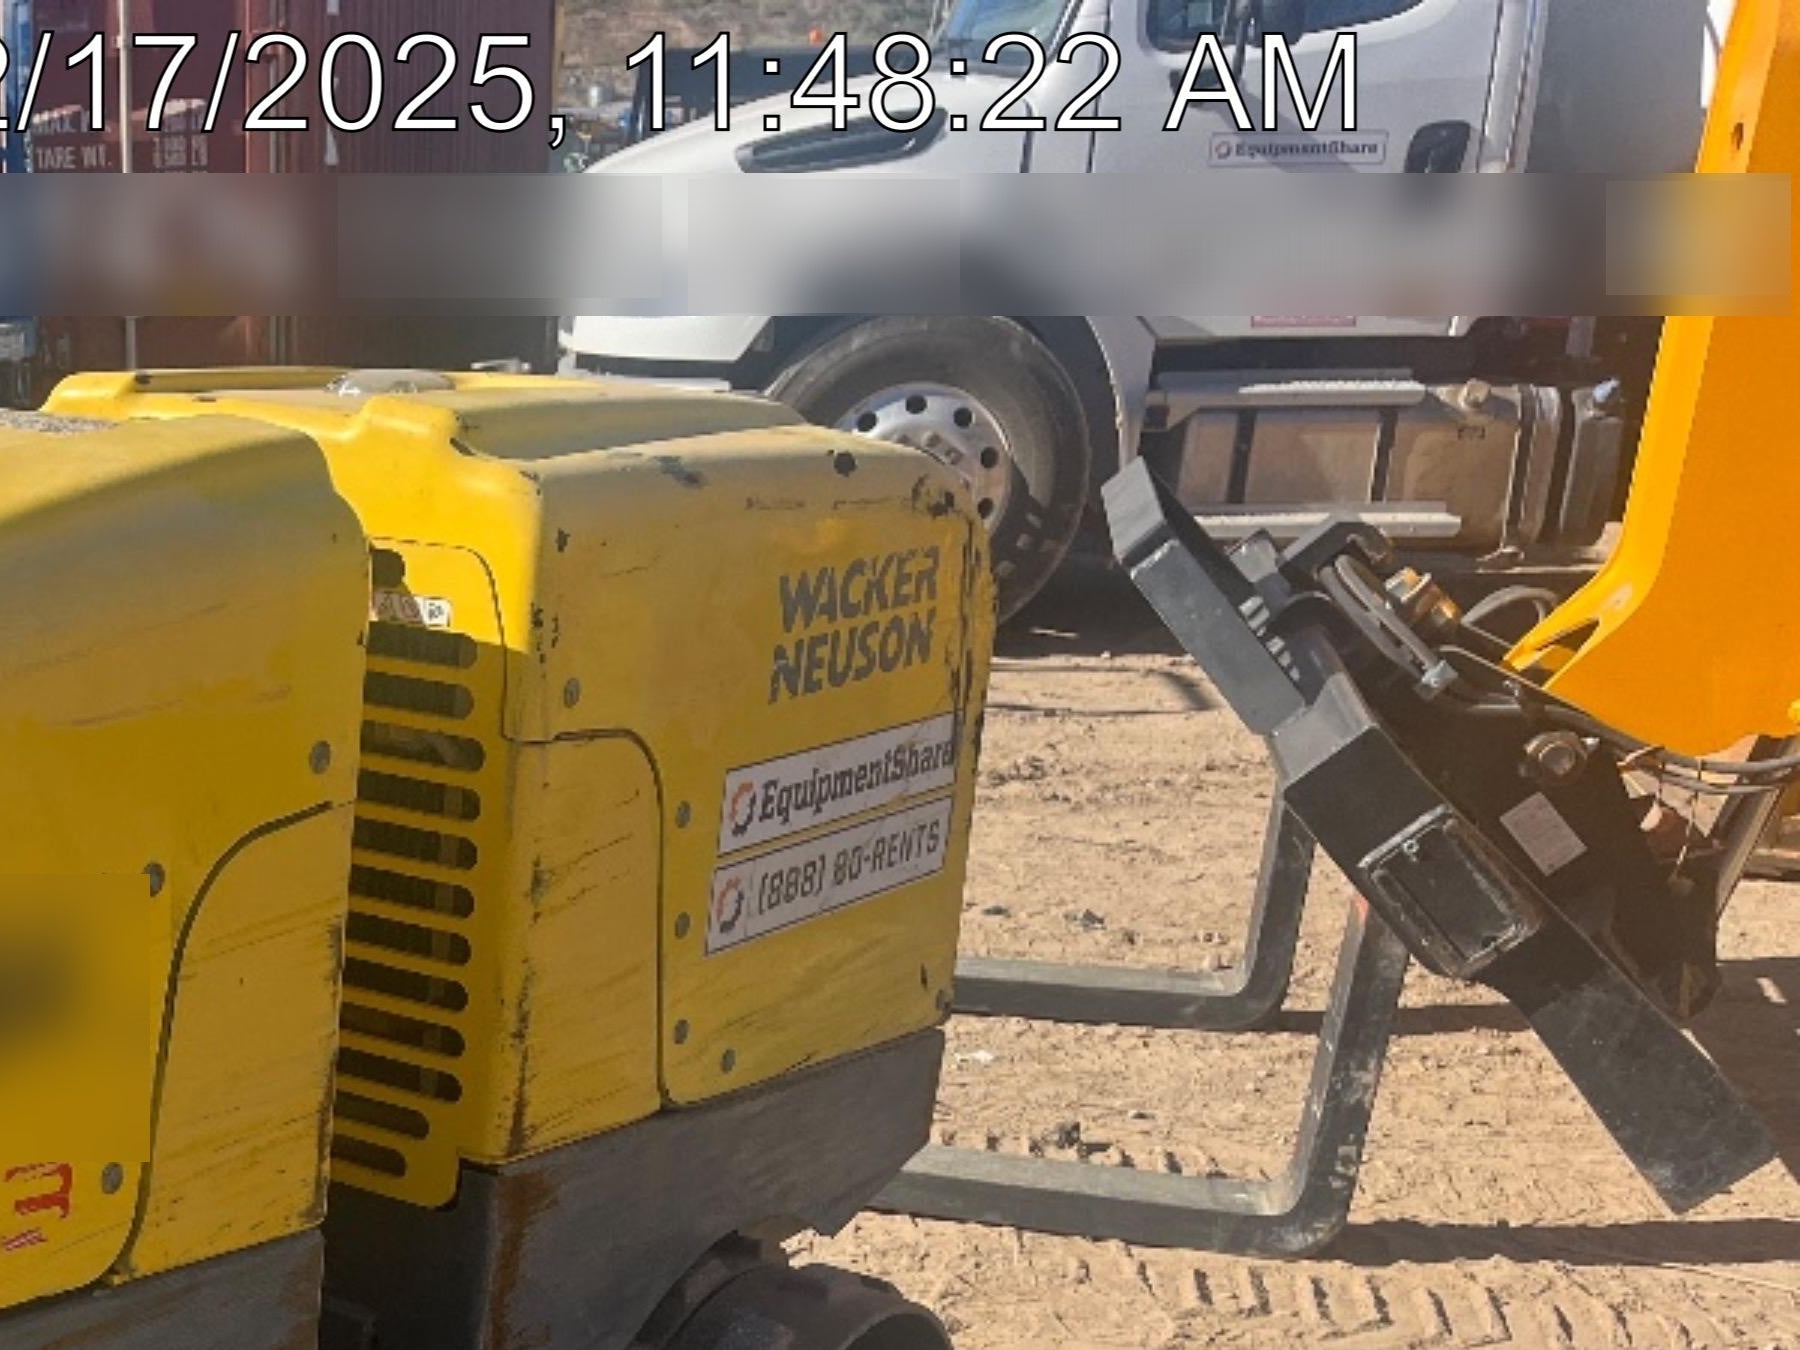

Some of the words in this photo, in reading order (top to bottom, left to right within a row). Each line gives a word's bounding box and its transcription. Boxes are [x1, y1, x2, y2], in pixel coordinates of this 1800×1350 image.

[778, 545, 940, 634] WACKER
[767, 606, 937, 707] NEUSON
[758, 739, 957, 826] EquipmentShare
[758, 854, 827, 916] (888)
[832, 818, 941, 887] 80-RENTS
